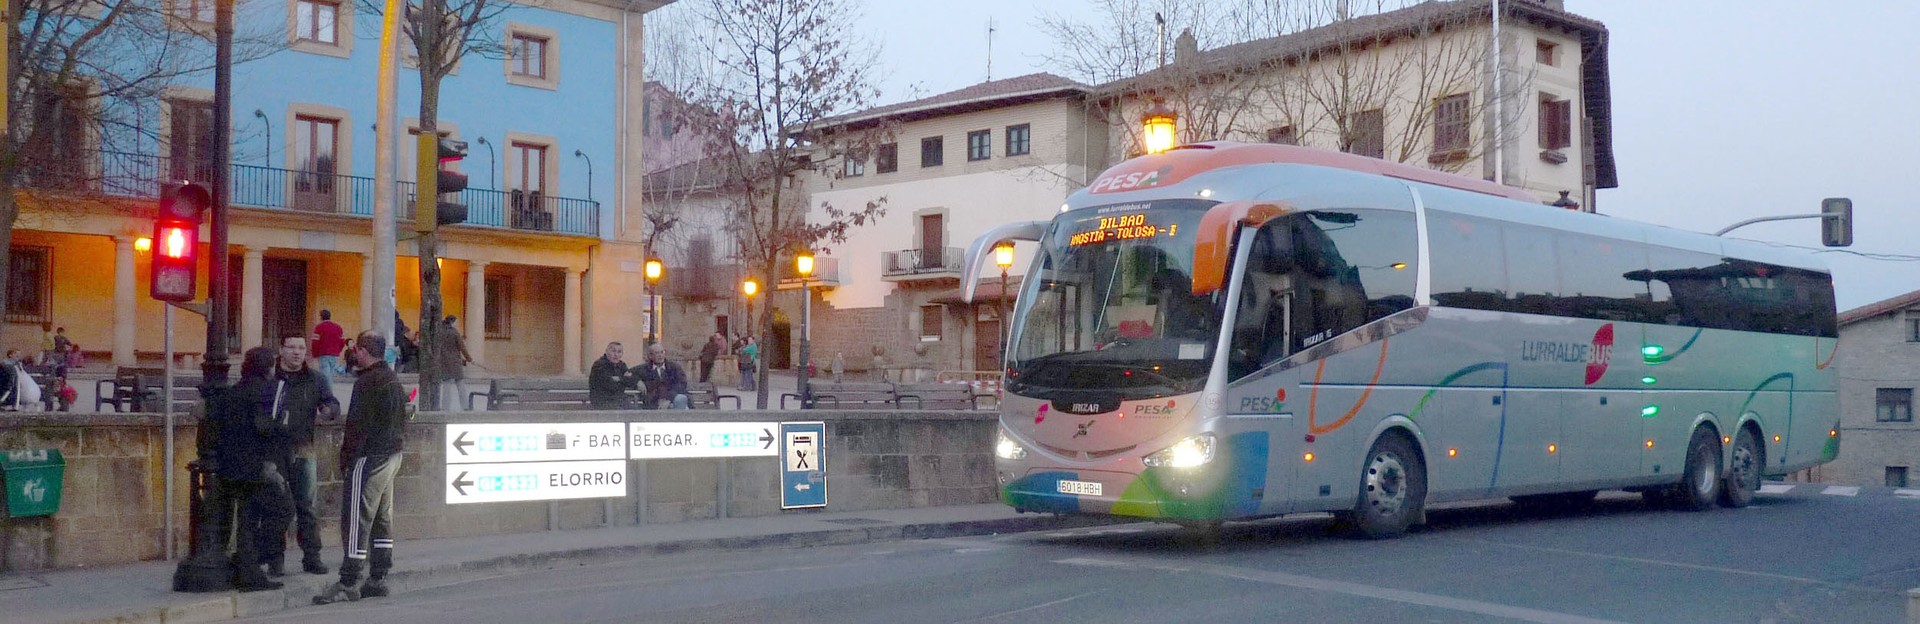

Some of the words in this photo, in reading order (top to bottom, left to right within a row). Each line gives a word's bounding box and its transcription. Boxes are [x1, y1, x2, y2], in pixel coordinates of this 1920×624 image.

[1092, 171, 1158, 193] PESA
[1099, 214, 1145, 230] BILBAO
[1117, 225, 1156, 239] TOLOSA
[1072, 403, 1099, 413] IRIZAR
[1135, 404, 1171, 414] PESA
[1240, 397, 1281, 411] PESA
[549, 471, 623, 487] ELORRIO
[1061, 481, 1082, 493] 6018
[1084, 484, 1100, 495] HBH
